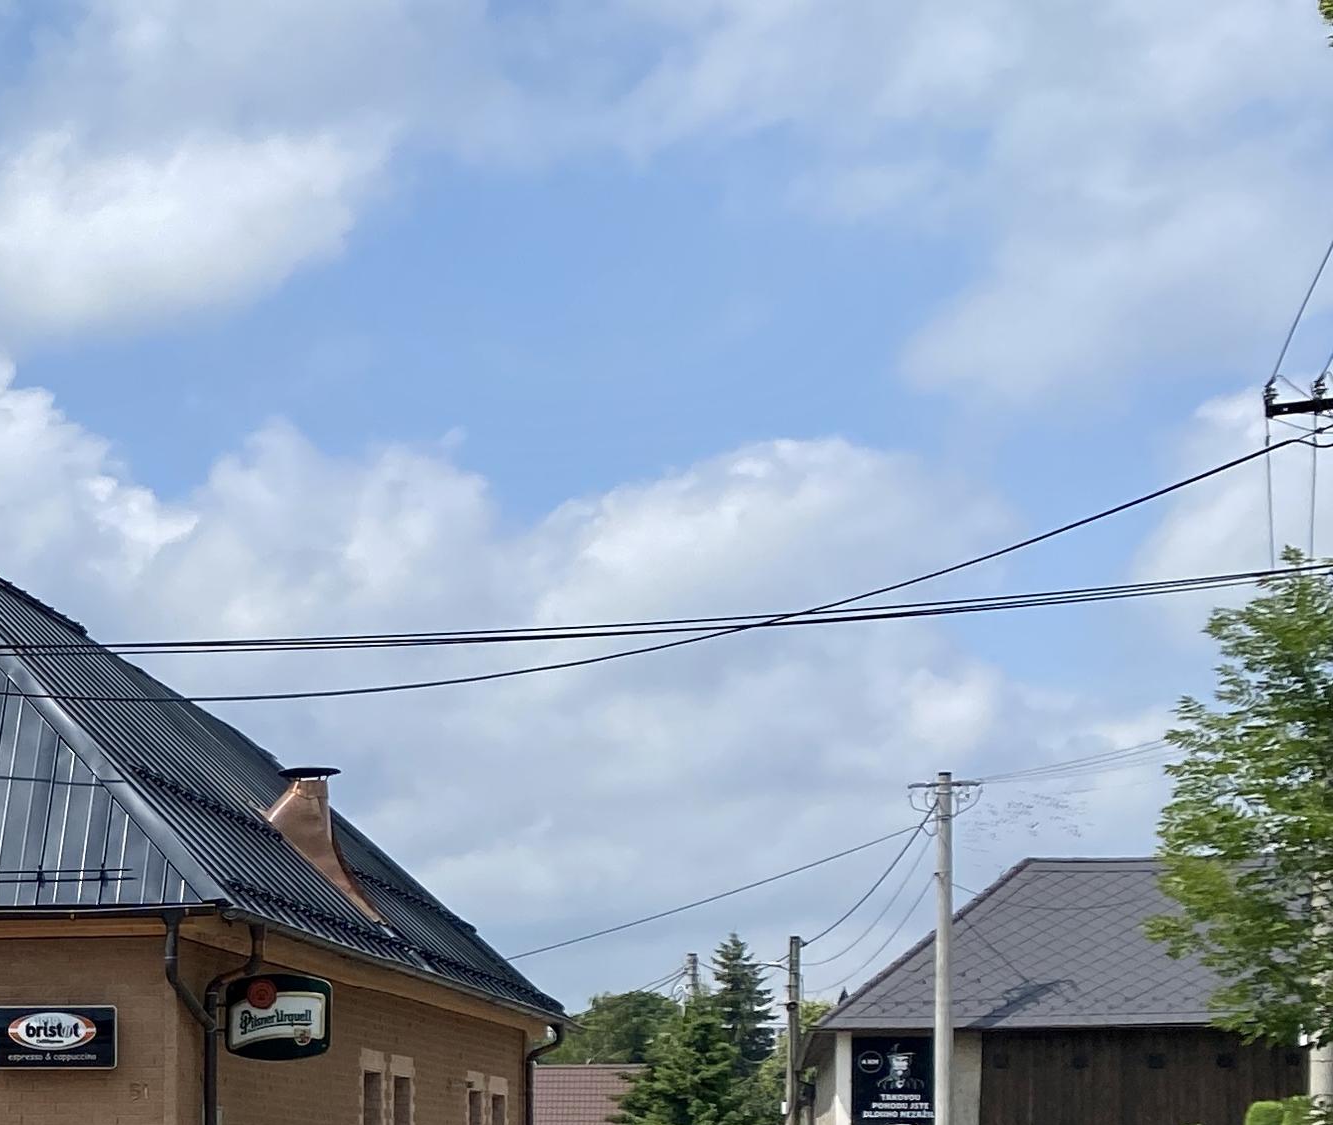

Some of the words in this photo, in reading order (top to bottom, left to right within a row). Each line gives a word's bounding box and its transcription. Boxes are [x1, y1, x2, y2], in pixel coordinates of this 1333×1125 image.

[25, 1022, 81, 1038] bristot
[240, 1009, 276, 1035] Pilsner
[275, 1008, 312, 1022] Urquell
